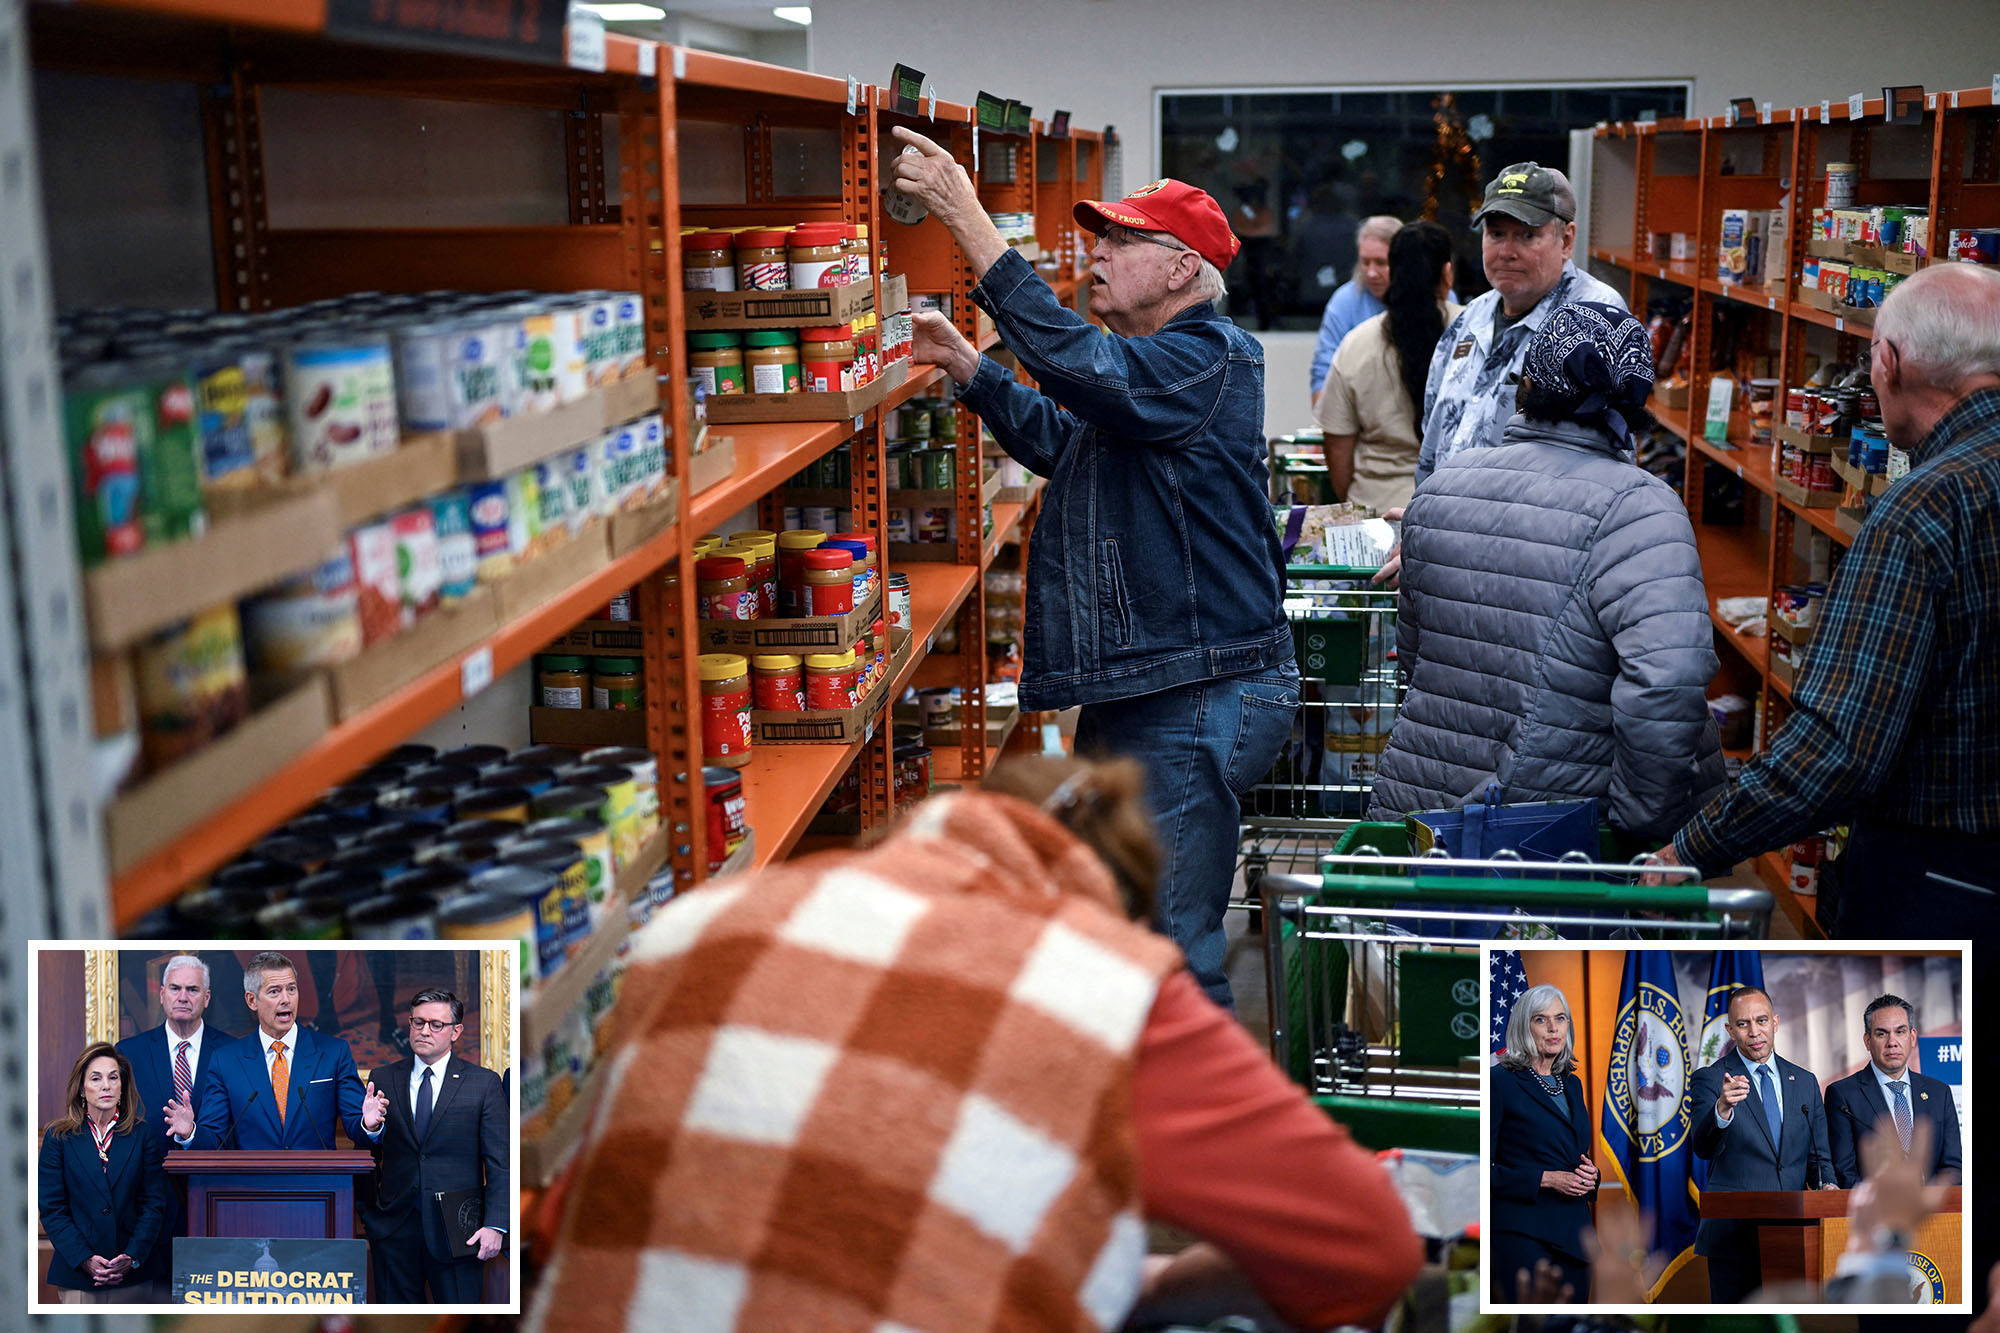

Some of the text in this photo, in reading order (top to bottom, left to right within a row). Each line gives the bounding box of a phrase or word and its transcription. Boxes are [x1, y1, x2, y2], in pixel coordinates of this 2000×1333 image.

[1100, 207, 1146, 225] THE PROUD
[1638, 989, 1667, 1020] U.S.
[189, 1270, 354, 1289] THE DEMOCRAT
[1927, 1267, 1941, 1284] OF
[184, 1291, 353, 1304] SHUTDOWN
